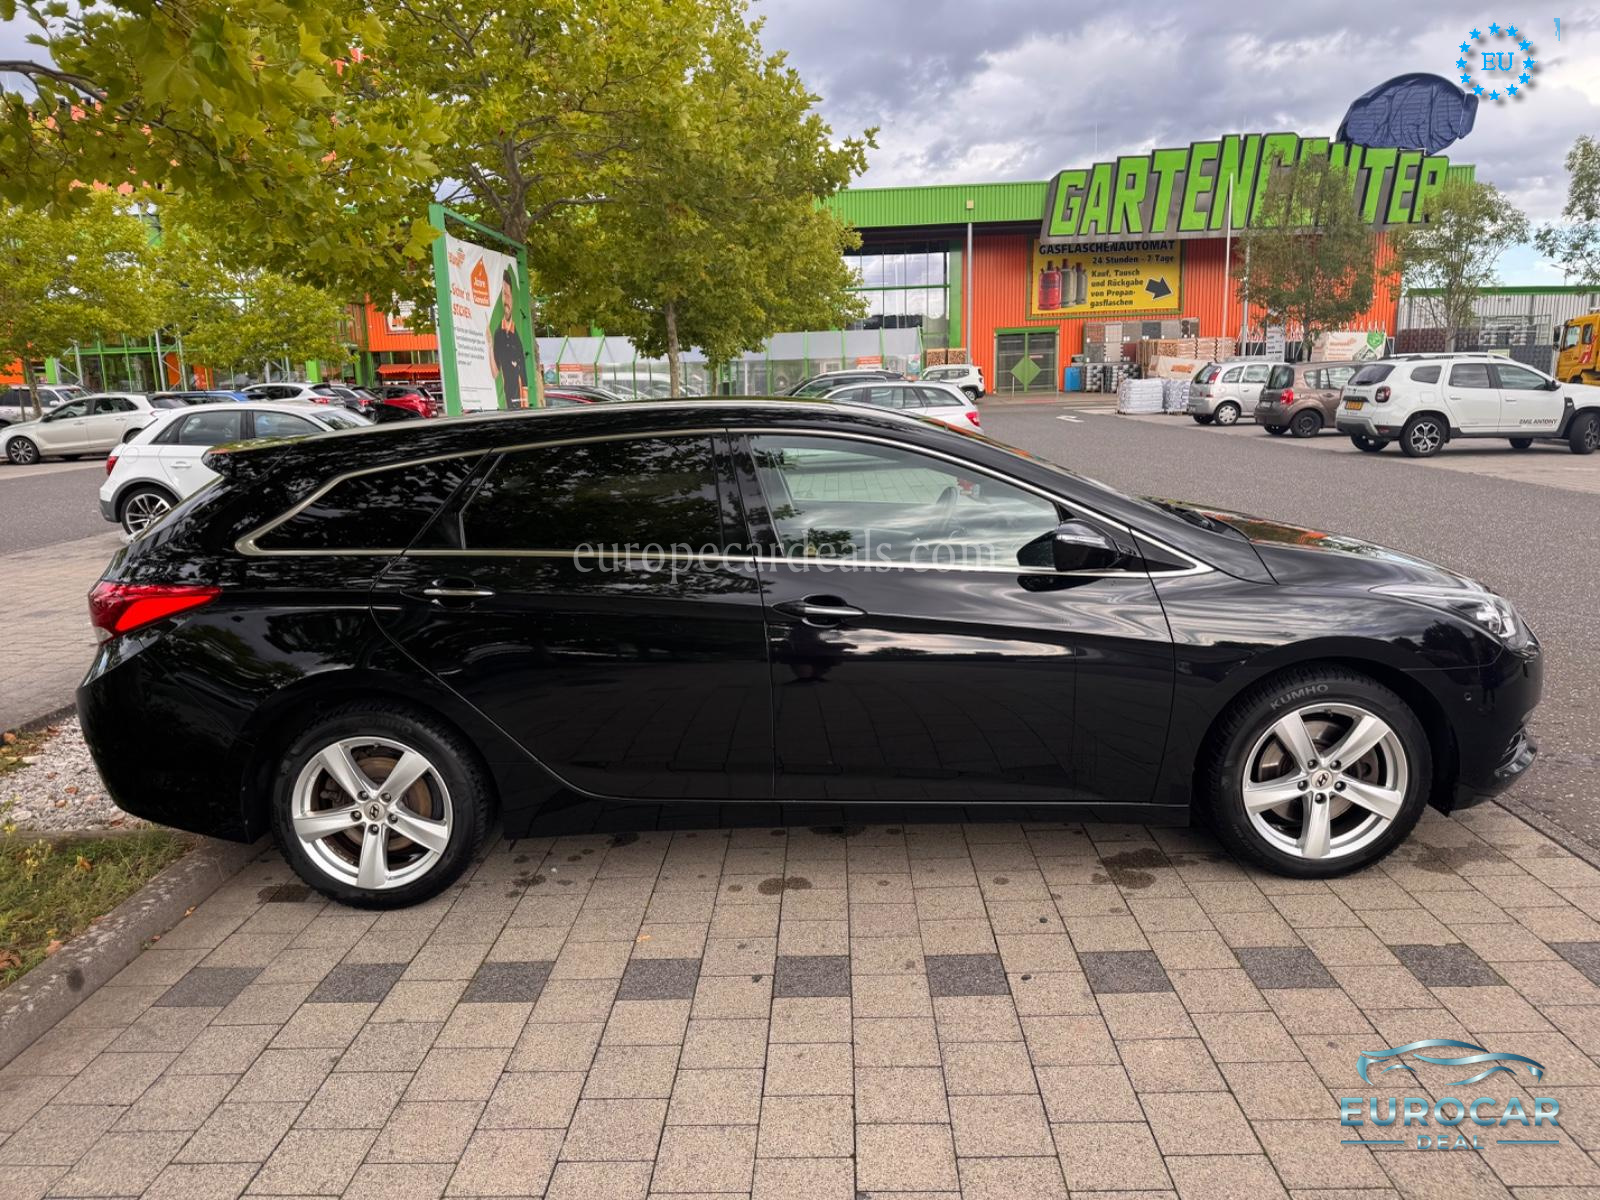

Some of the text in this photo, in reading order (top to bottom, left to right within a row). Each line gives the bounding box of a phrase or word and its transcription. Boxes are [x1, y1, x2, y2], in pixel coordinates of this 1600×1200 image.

[1049, 132, 1449, 237] GARTENCENTER
[1039, 240, 1176, 255] GASFLASCHENAUTOMAT
[1092, 256, 1103, 264] 24
[1105, 255, 1139, 264] Stunden
[1147, 255, 1152, 263] 7
[1155, 254, 1174, 264] Tage
[1091, 268, 1140, 277] Kauf, Tausch
[1107, 278, 1144, 288] Rückgabe
[1106, 289, 1136, 298] Propan-
[1090, 299, 1134, 308] gasflaschen
[1270, 684, 1329, 710] KUMHO
